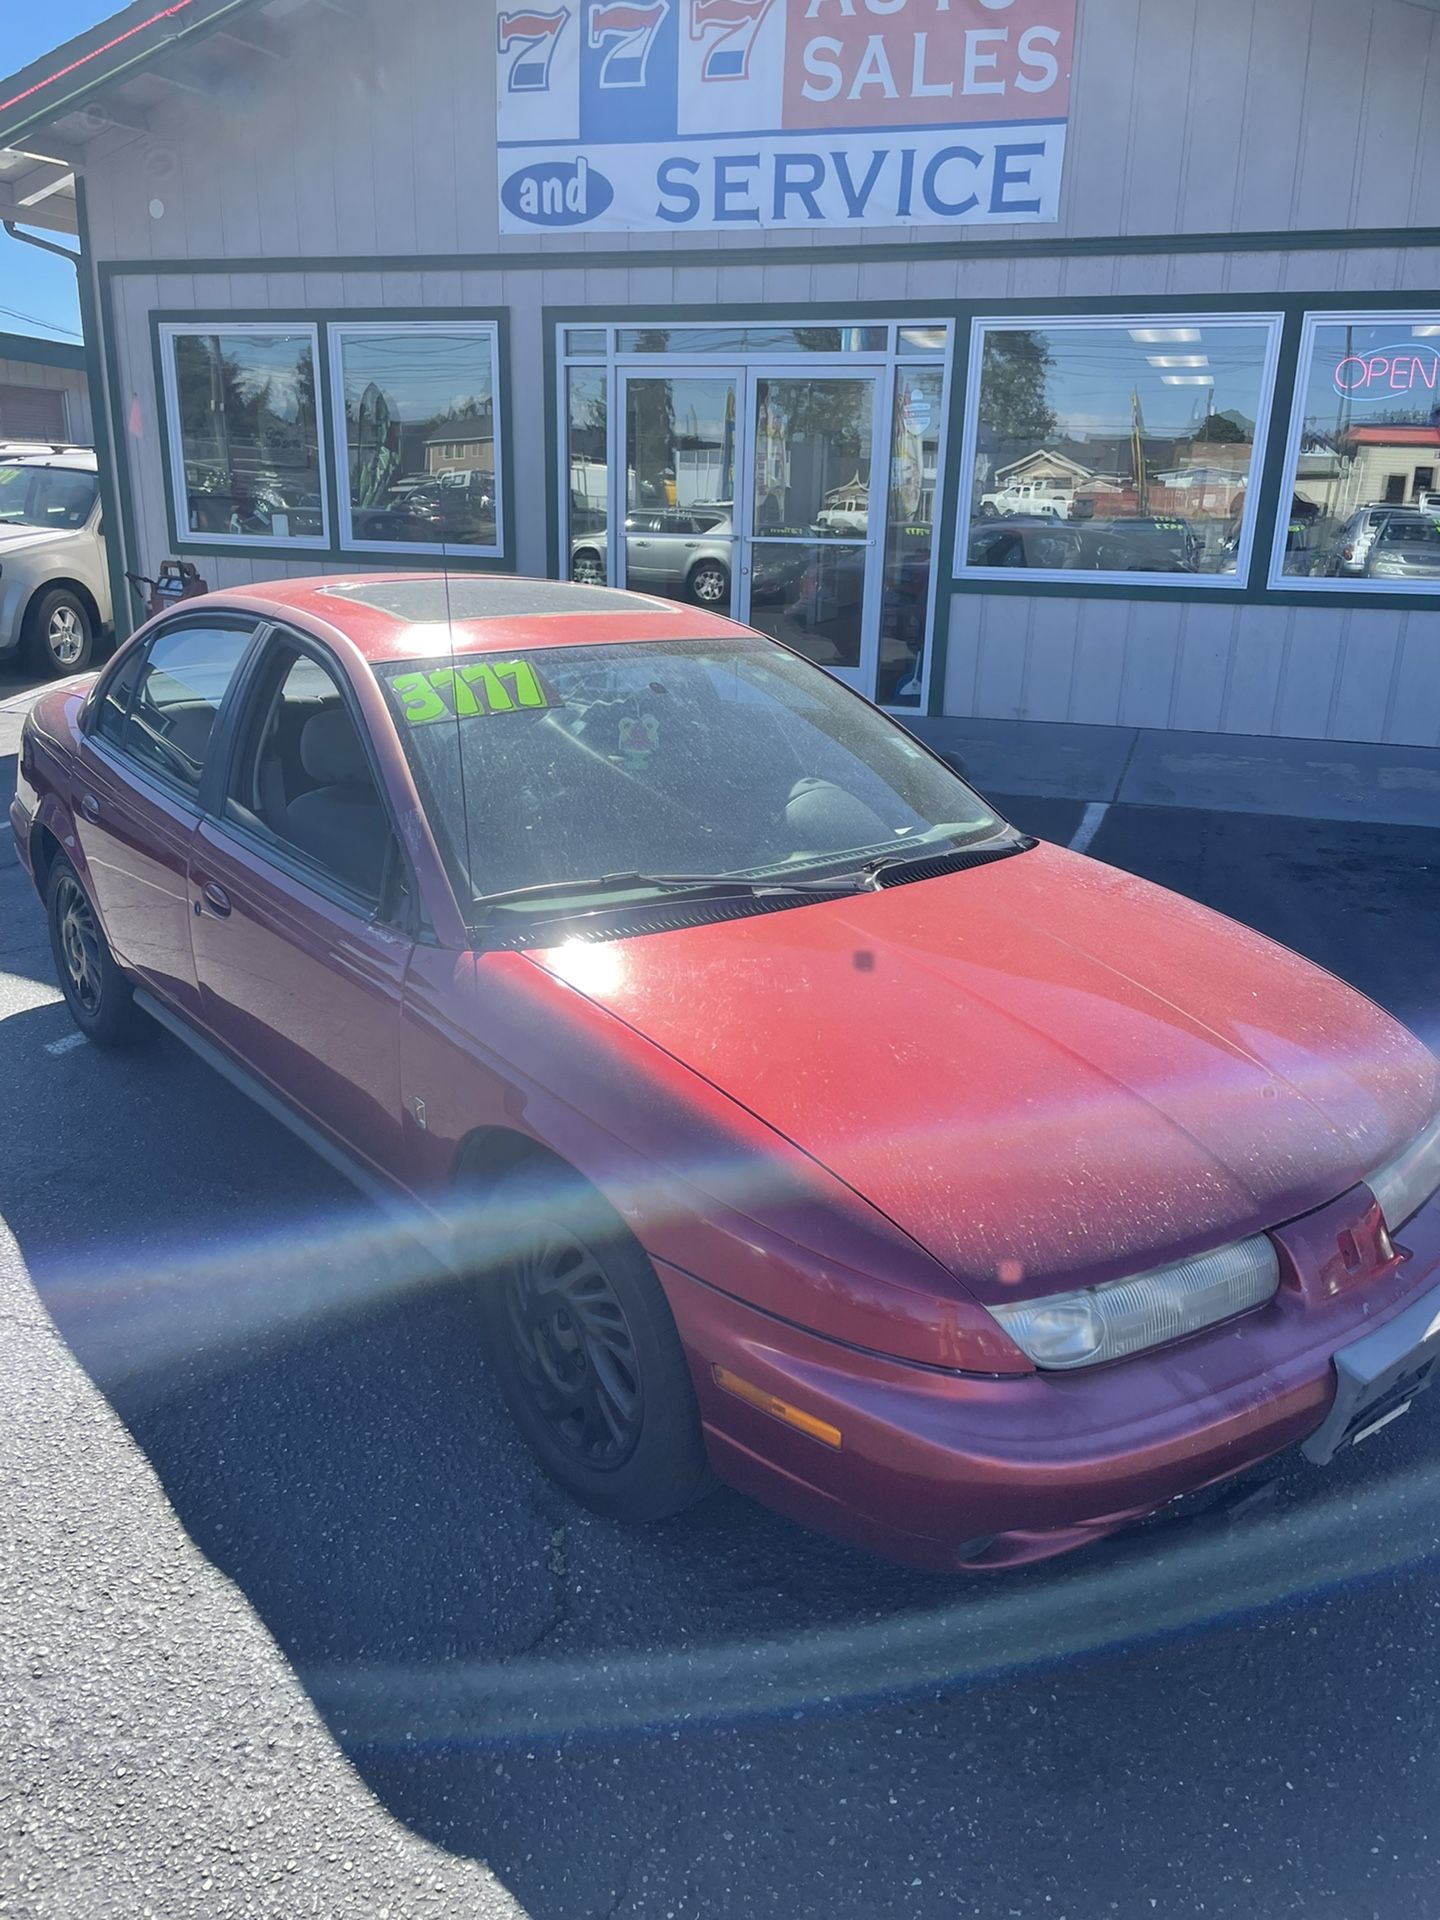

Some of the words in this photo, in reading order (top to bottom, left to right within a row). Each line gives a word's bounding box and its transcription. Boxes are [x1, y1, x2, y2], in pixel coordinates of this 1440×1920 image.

[801, 25, 1061, 102] SALES
[518, 155, 589, 215] and
[655, 141, 1046, 223] SERVICE
[1334, 357, 1437, 389] OPEN
[392, 659, 546, 723] 3777
